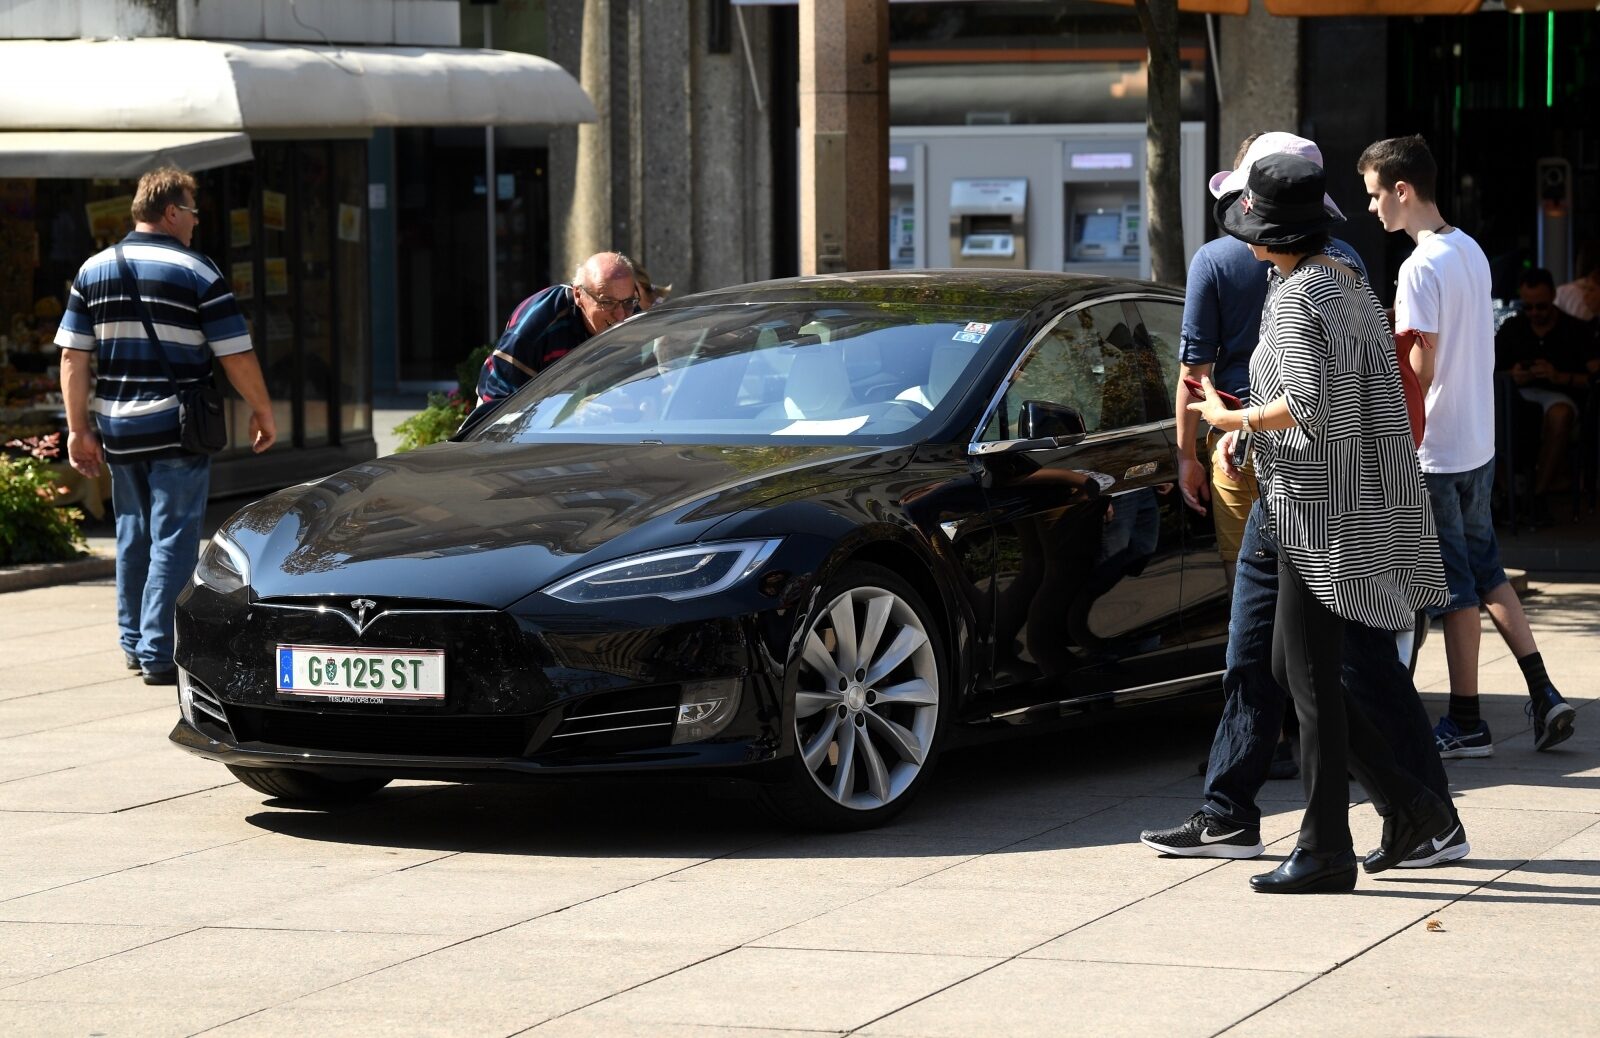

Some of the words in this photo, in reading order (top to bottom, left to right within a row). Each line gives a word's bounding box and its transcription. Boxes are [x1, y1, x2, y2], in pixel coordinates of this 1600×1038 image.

[308, 656, 322, 686] G
[341, 657, 385, 689] 125
[391, 659, 423, 690] ST
[284, 675, 290, 684] A
[327, 696, 384, 704] TESLAMOTORS.COM
